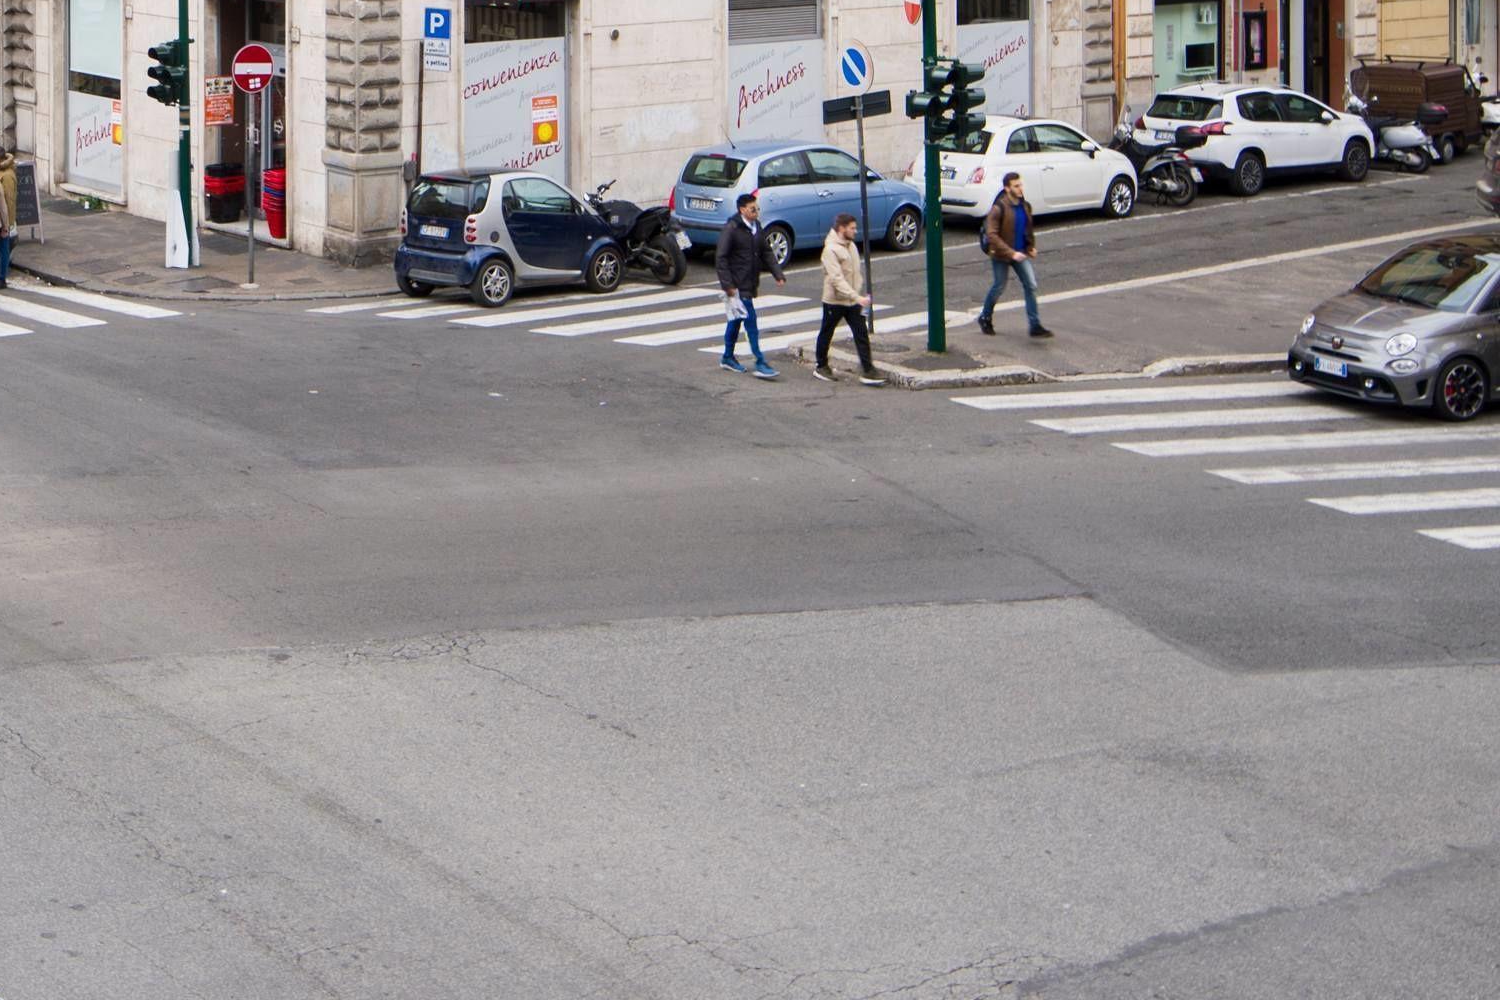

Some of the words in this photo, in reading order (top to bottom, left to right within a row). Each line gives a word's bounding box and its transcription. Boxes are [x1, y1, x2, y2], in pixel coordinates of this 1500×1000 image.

[430, 12, 445, 34] P
[463, 50, 561, 101] convenienza
[736, 61, 807, 129] freshness
[75, 115, 112, 168] freshne
